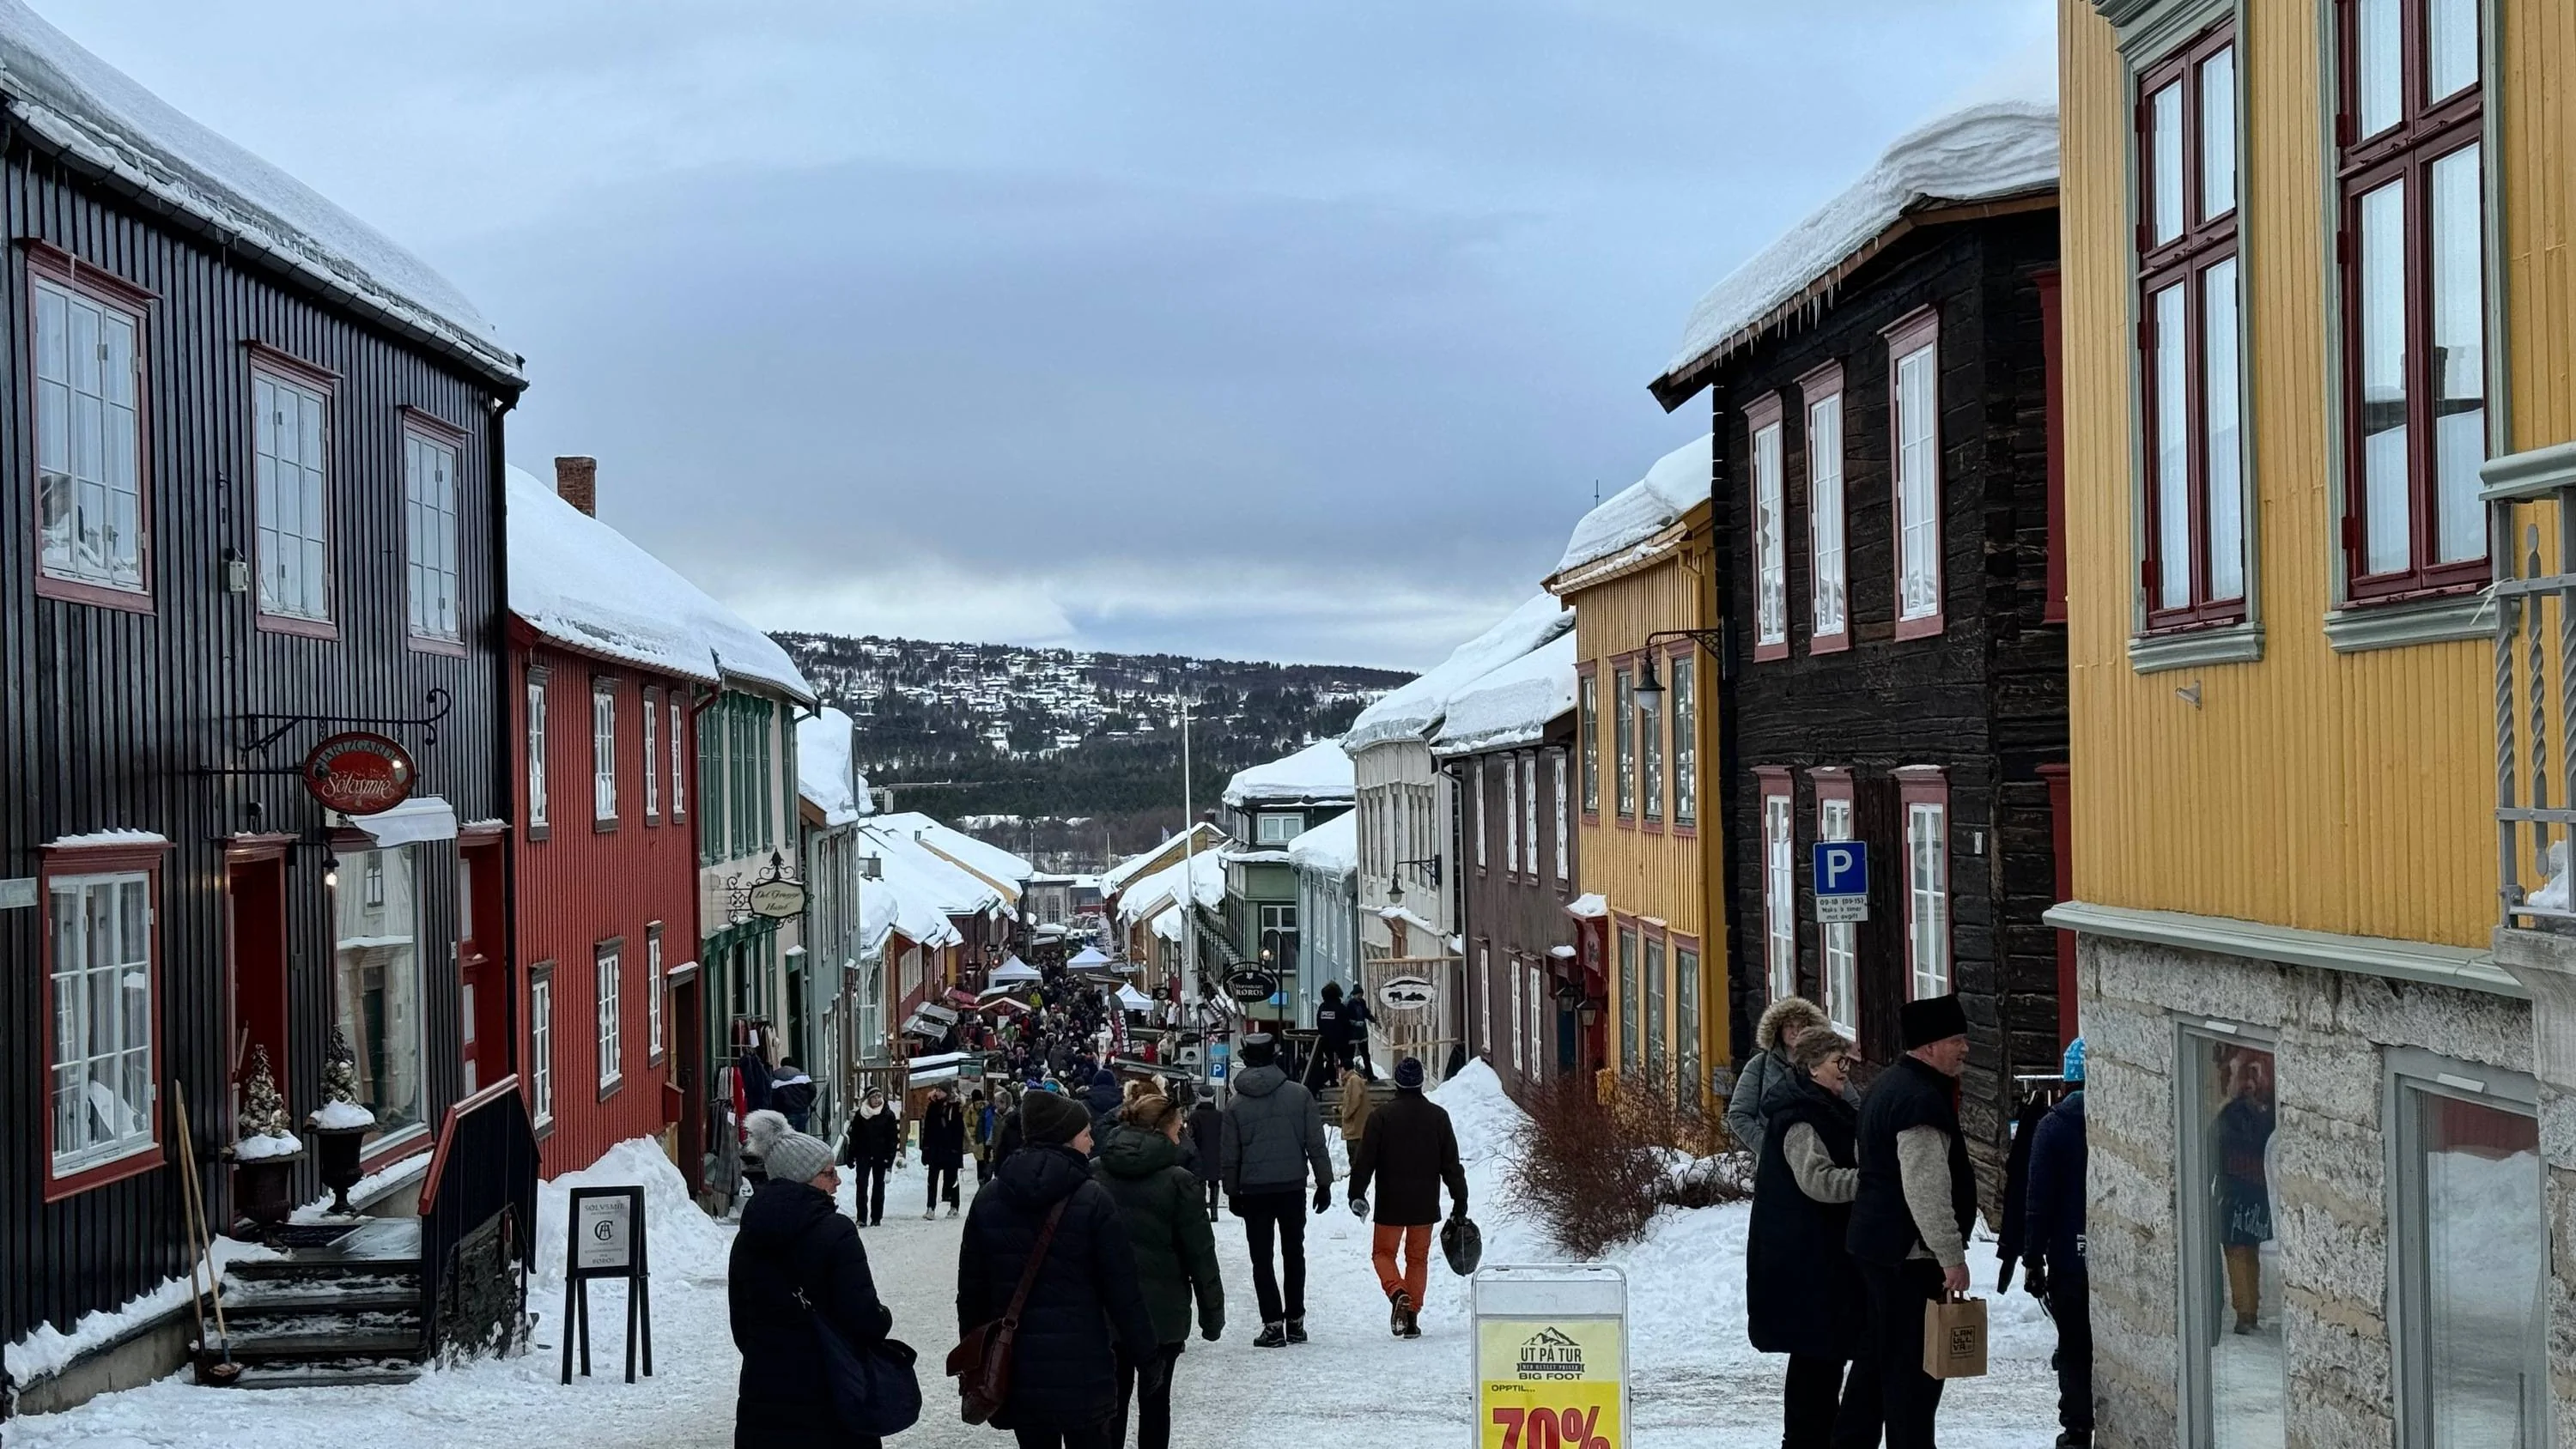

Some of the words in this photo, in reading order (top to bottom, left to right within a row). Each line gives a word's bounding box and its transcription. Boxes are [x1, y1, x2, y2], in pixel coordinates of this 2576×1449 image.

[1826, 849, 1853, 888] P
[1213, 1064, 1222, 1076] P
[1521, 1348, 1536, 1361] UT
[1540, 1344, 1554, 1361] PÅ
[1558, 1348, 1582, 1362] TUR
[1492, 1405, 1611, 1449] 70%
